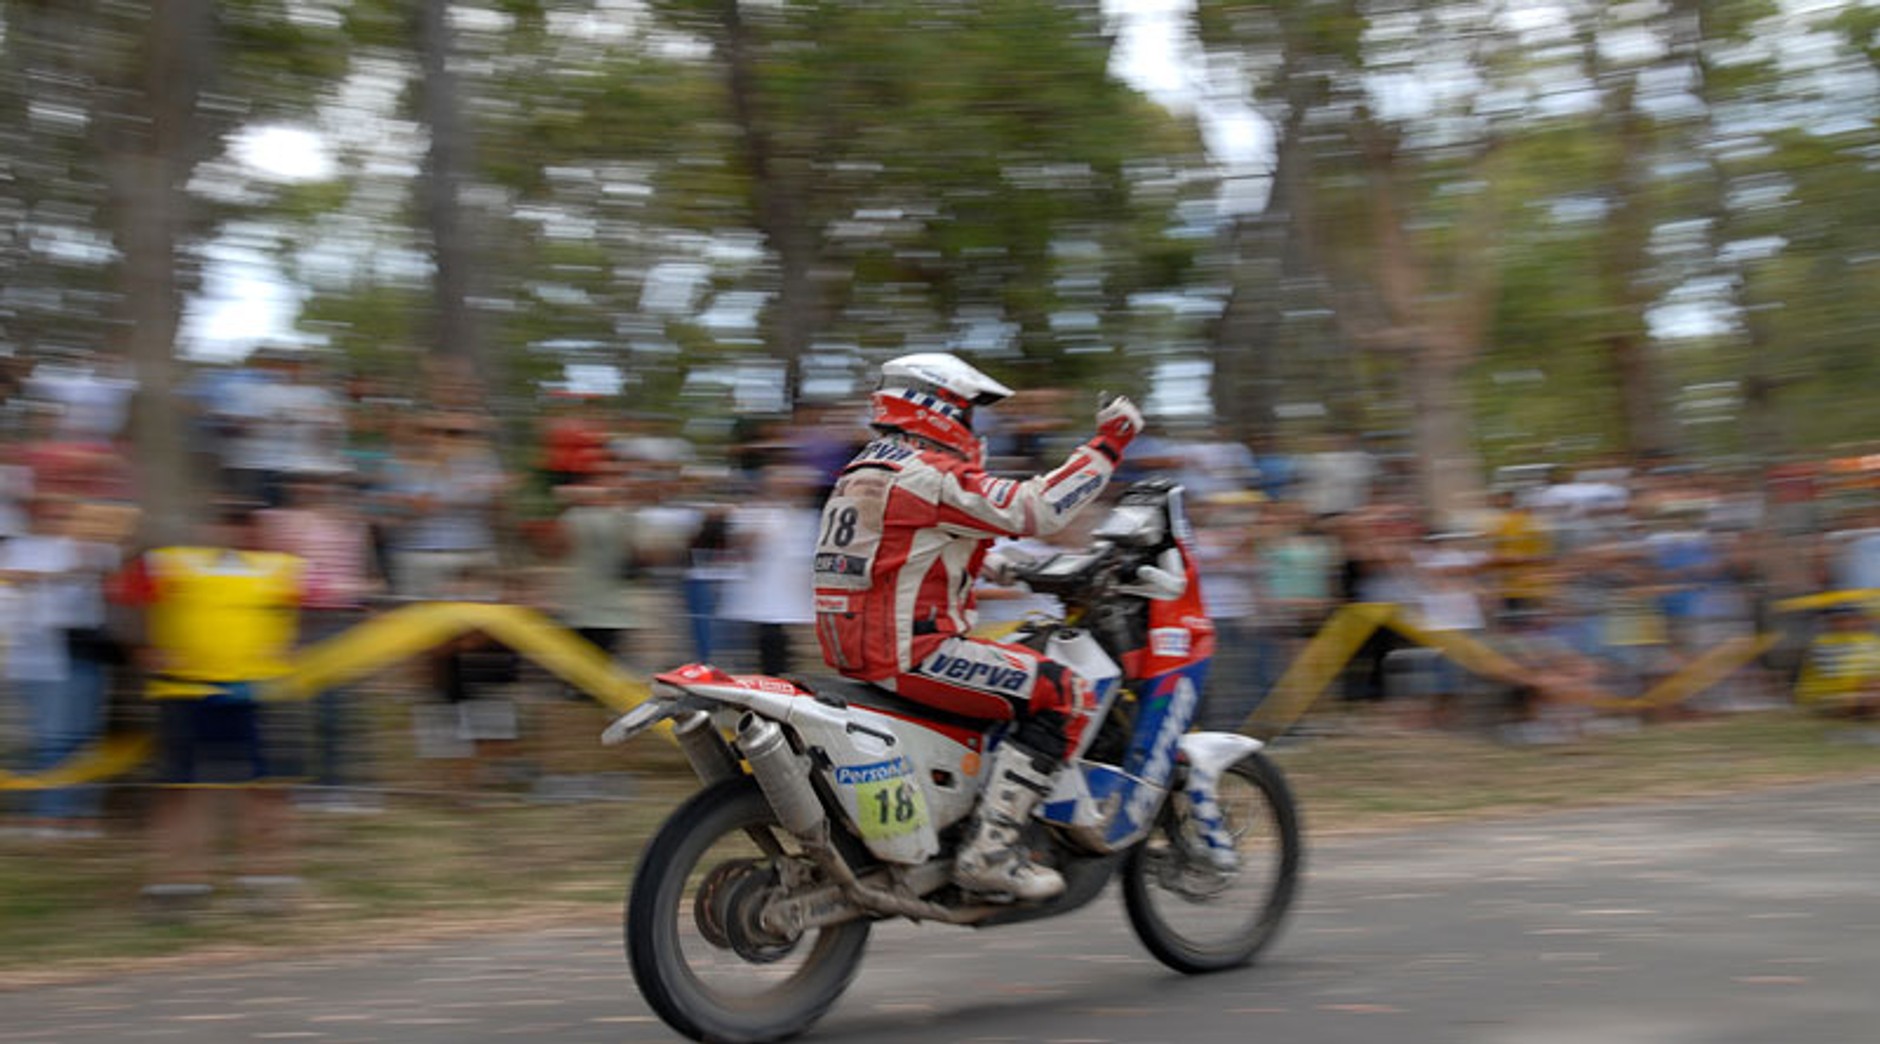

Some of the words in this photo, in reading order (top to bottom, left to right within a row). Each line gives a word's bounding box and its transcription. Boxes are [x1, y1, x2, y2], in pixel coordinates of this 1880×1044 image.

[821, 507, 859, 547] 18
[930, 653, 1029, 691] verva
[874, 783, 914, 824] 18
